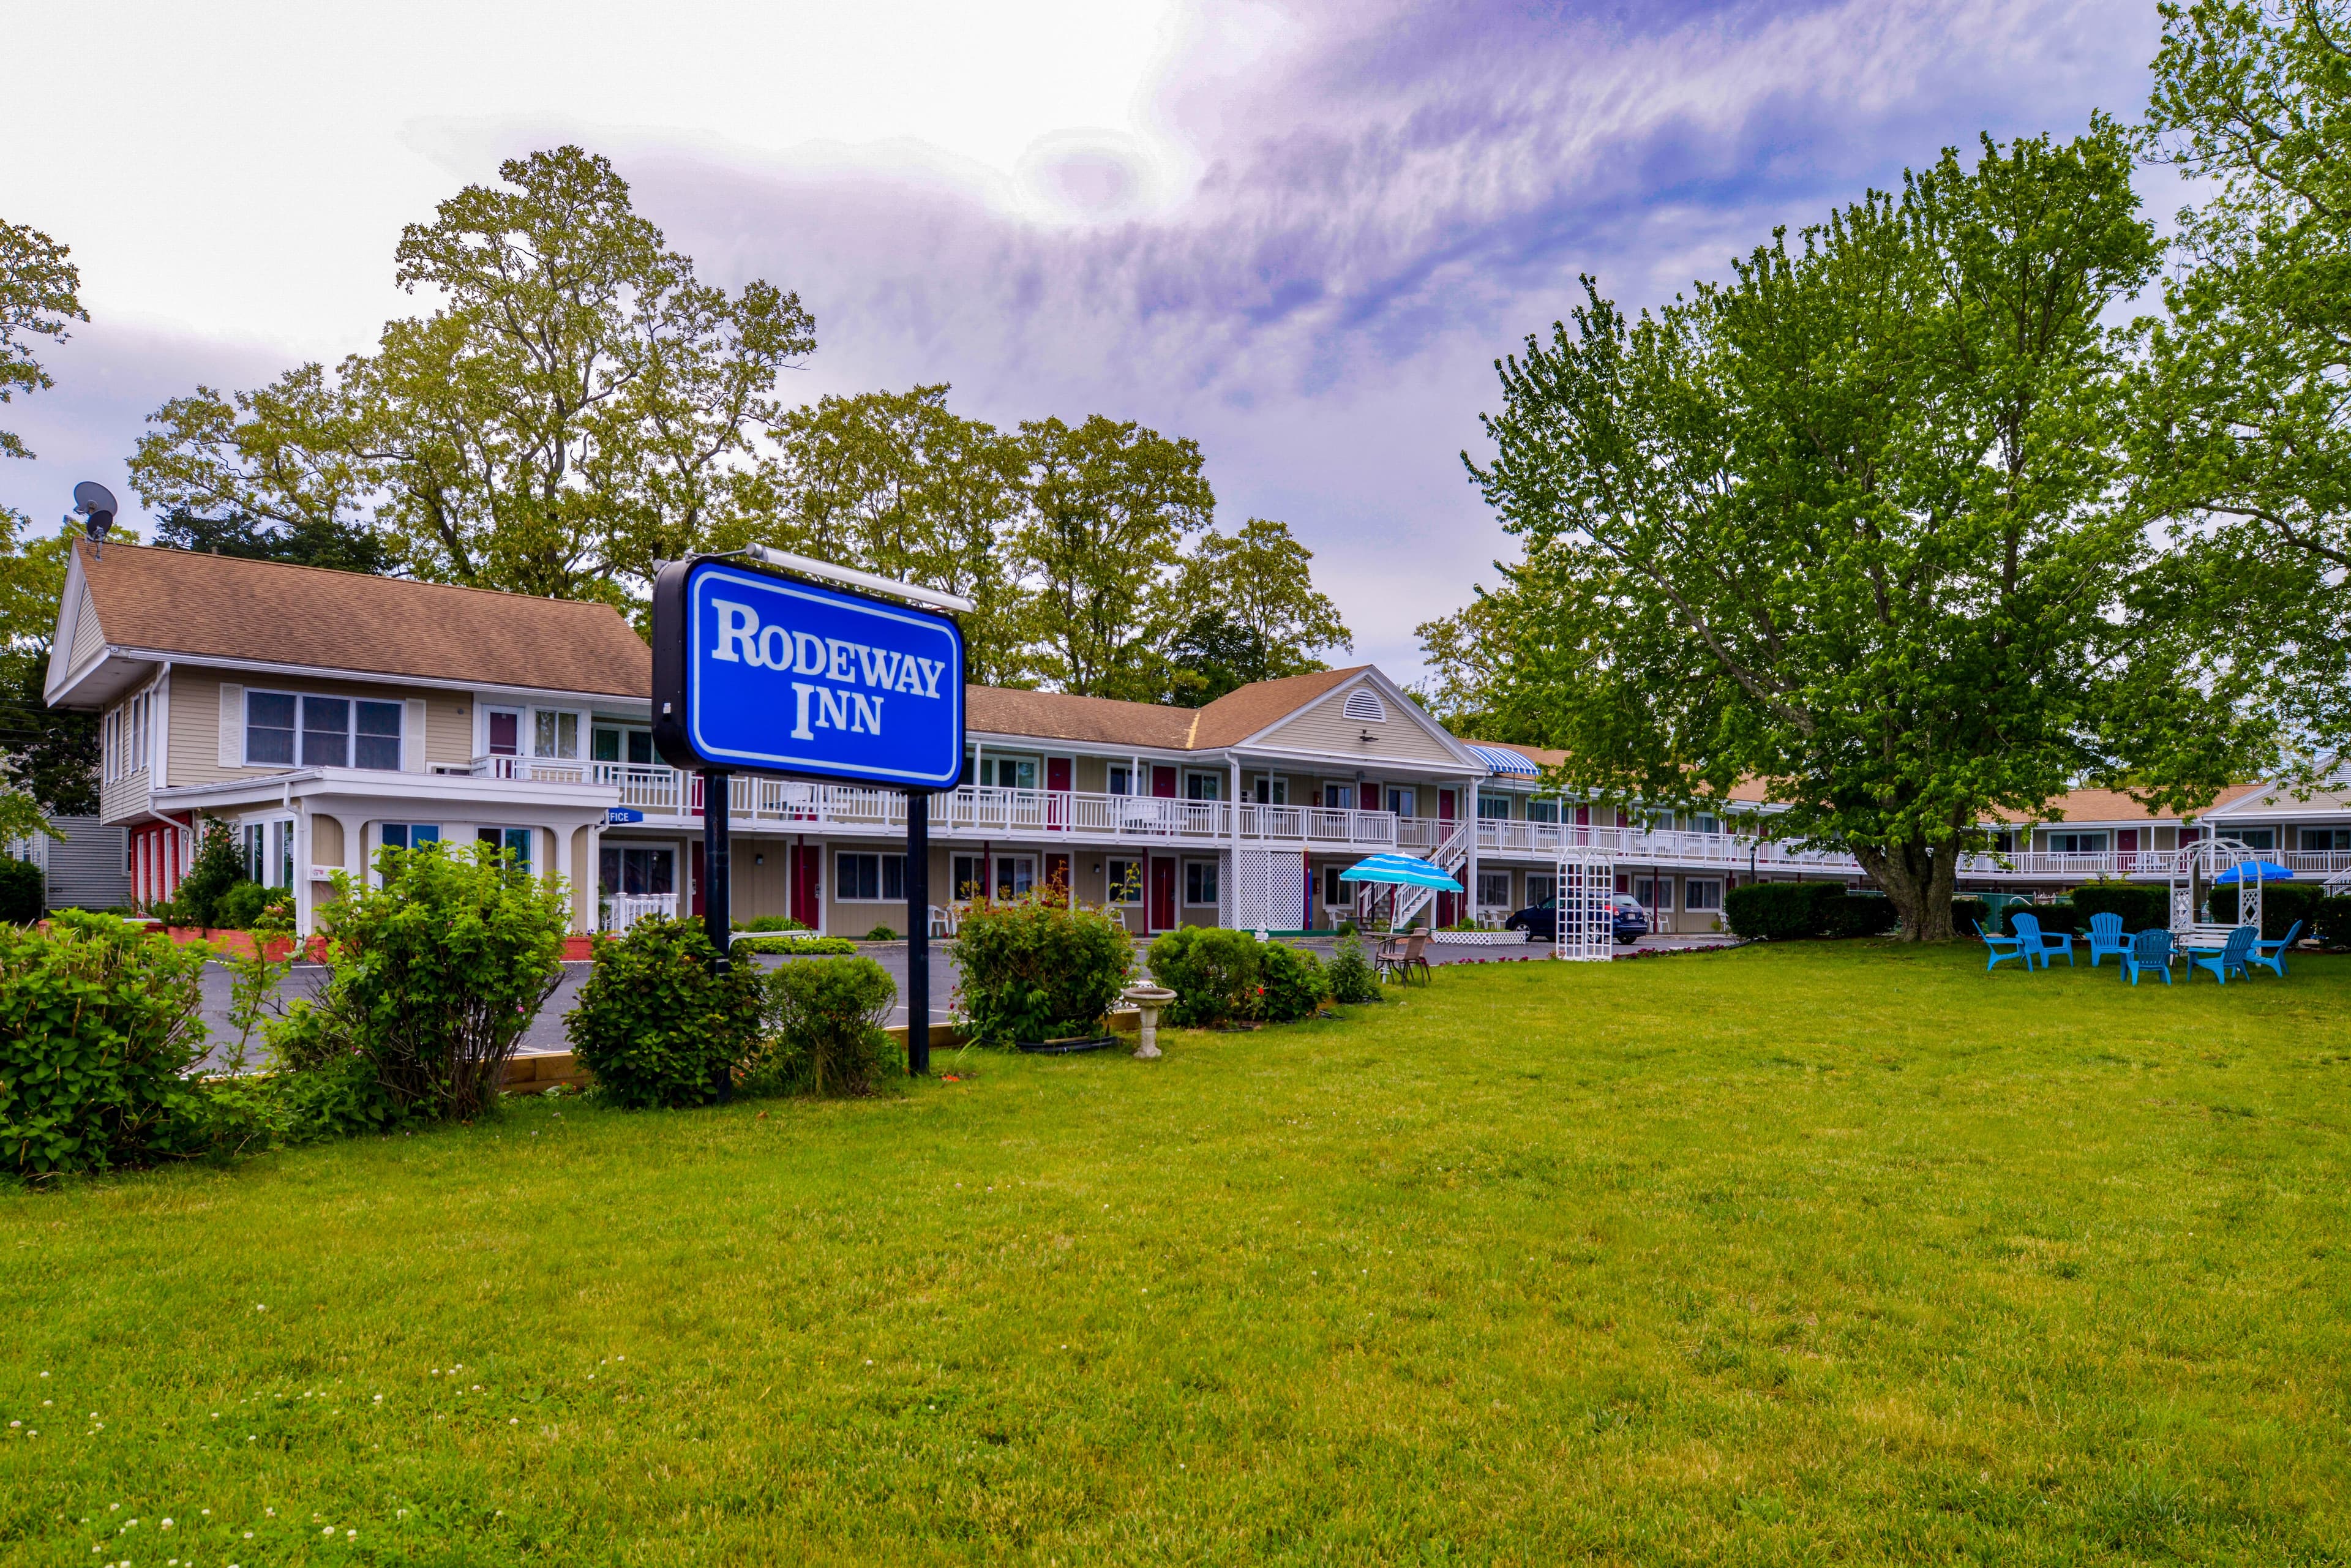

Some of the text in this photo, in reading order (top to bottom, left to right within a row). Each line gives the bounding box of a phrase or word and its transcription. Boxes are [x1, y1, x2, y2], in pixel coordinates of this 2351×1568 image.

[711, 598, 945, 699] RODEWAY
[790, 682, 884, 741] INN
[608, 812, 629, 821] FICE
